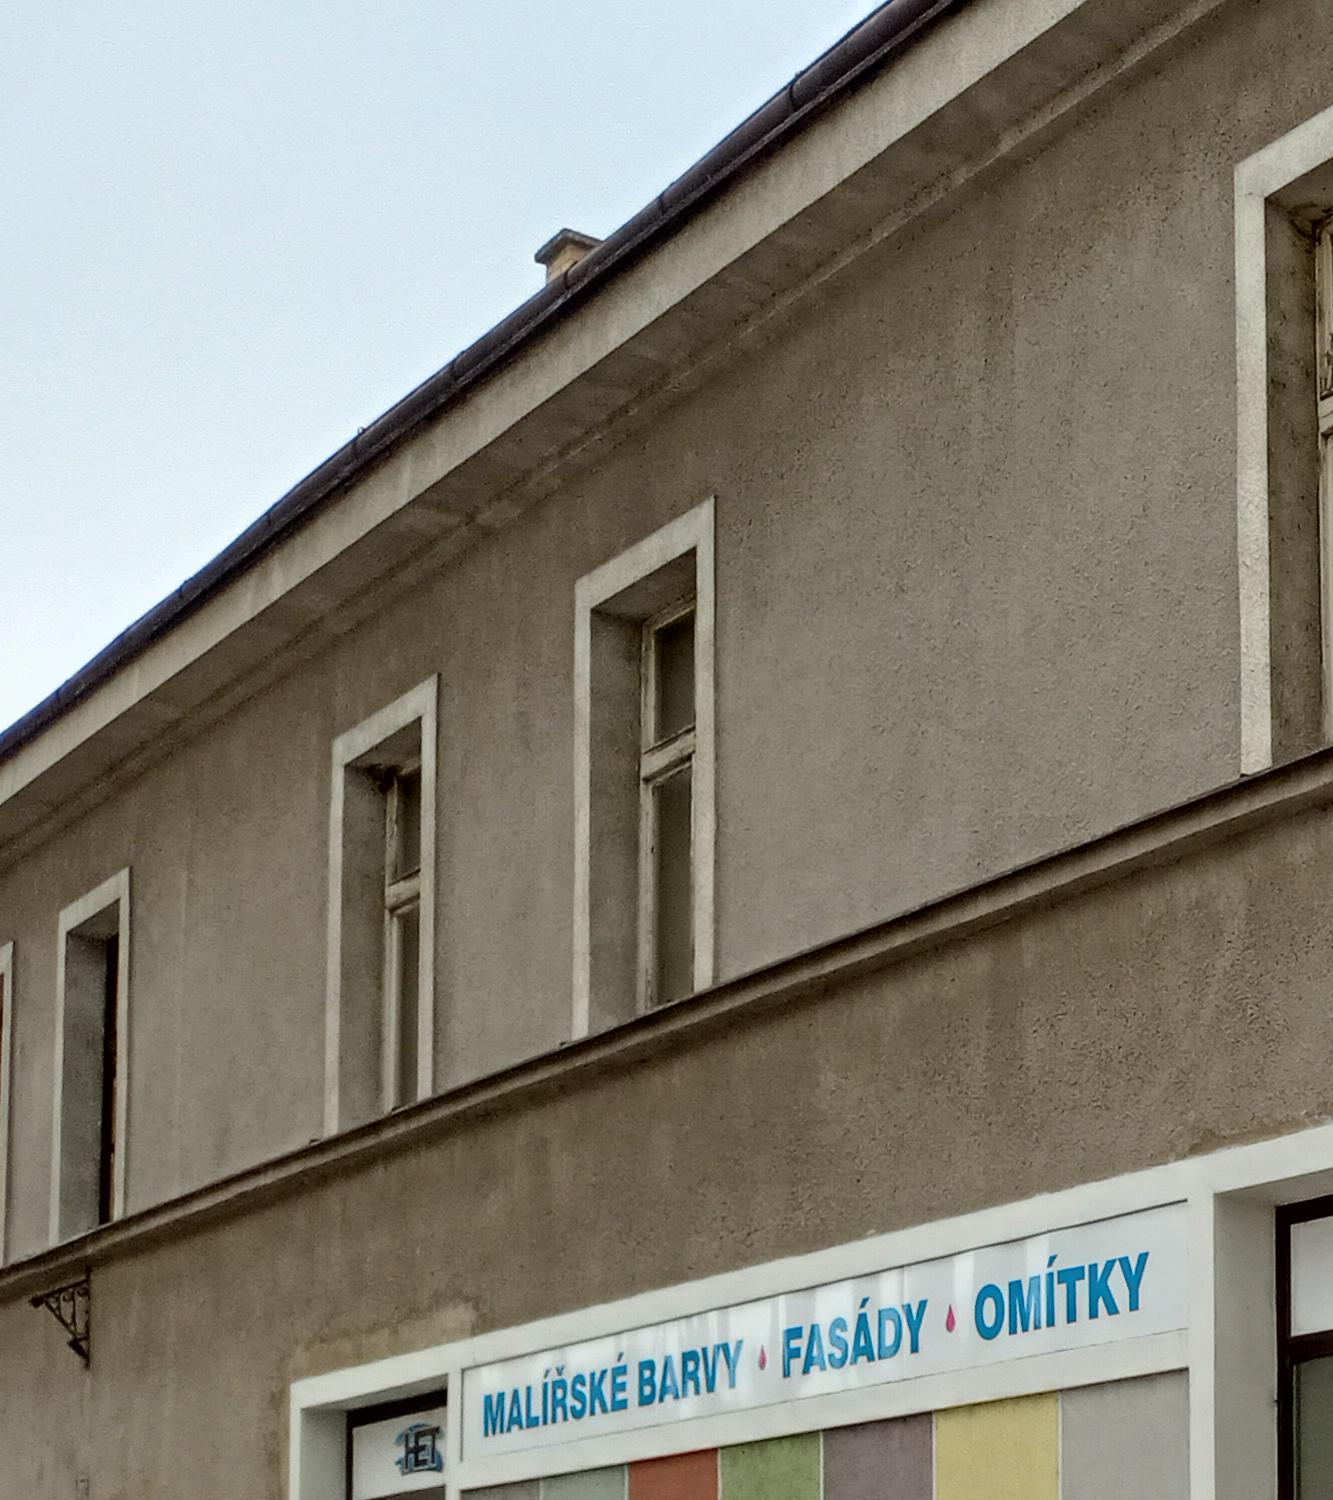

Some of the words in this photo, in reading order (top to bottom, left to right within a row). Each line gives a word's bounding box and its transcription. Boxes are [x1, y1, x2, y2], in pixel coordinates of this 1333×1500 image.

[483, 1352, 629, 1438] MALÍŘSKÉ
[637, 1339, 744, 1407] BARVY
[782, 1296, 928, 1378] FASÁDY
[974, 1251, 1150, 1340] OMÍTKY
[404, 1426, 441, 1469] HET
